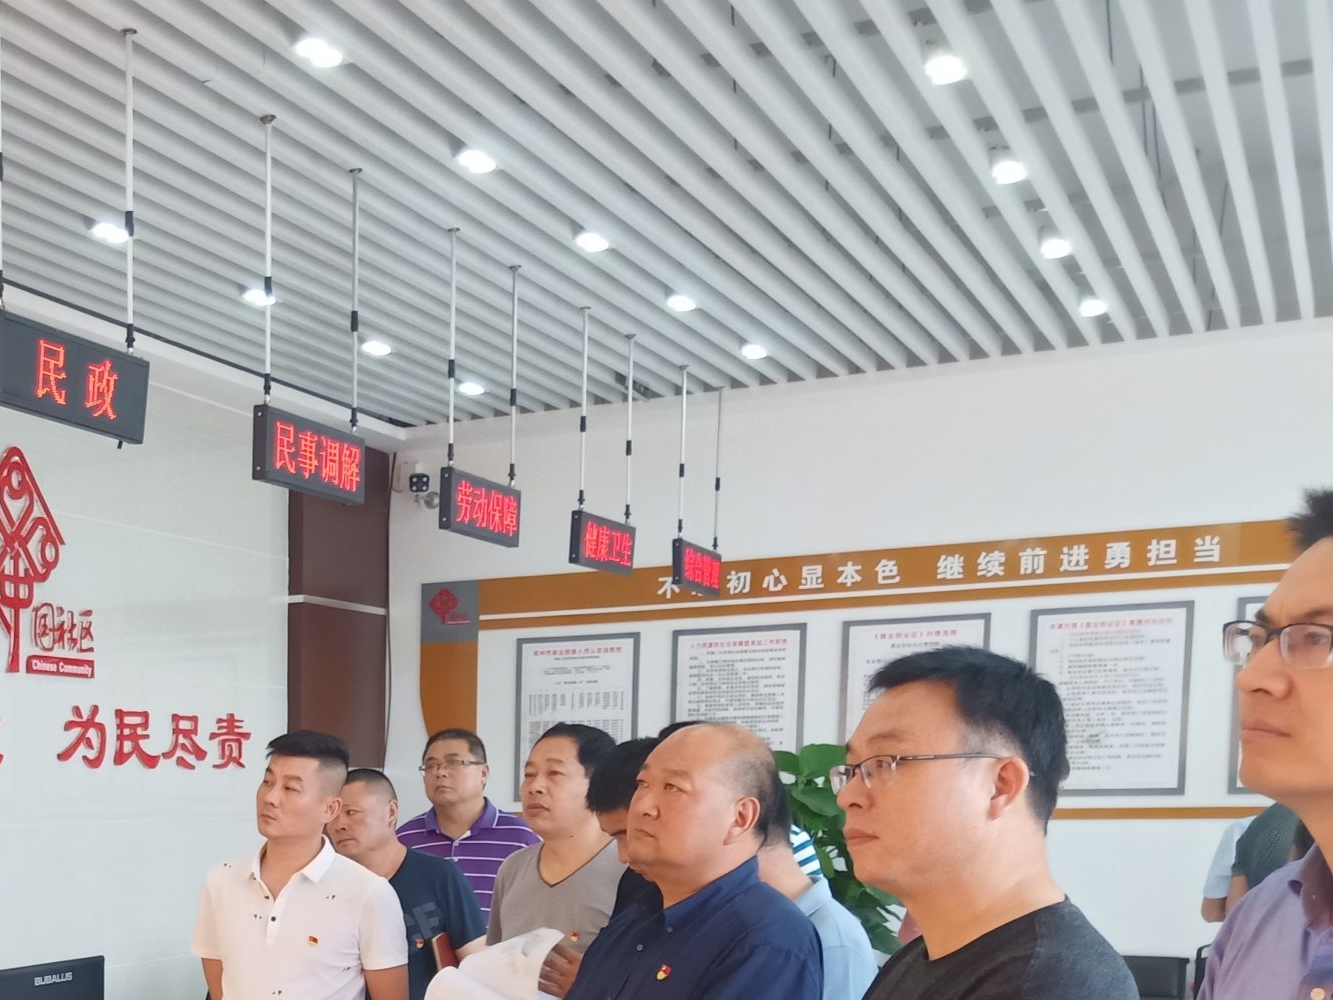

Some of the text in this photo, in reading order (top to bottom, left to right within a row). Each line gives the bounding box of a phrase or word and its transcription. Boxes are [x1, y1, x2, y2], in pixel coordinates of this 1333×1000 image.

[35, 338, 118, 420] 民政
[274, 420, 361, 493] 民事调解
[456, 479, 518, 537] 劳动保障
[584, 520, 632, 568] 健康卫生
[657, 535, 1222, 599] 不初心显本色 继续前进勇担当
[32, 659, 93, 678] Chinese Community
[56, 703, 252, 770] 为民尽责
[33, 971, 73, 987] BUBALUS
